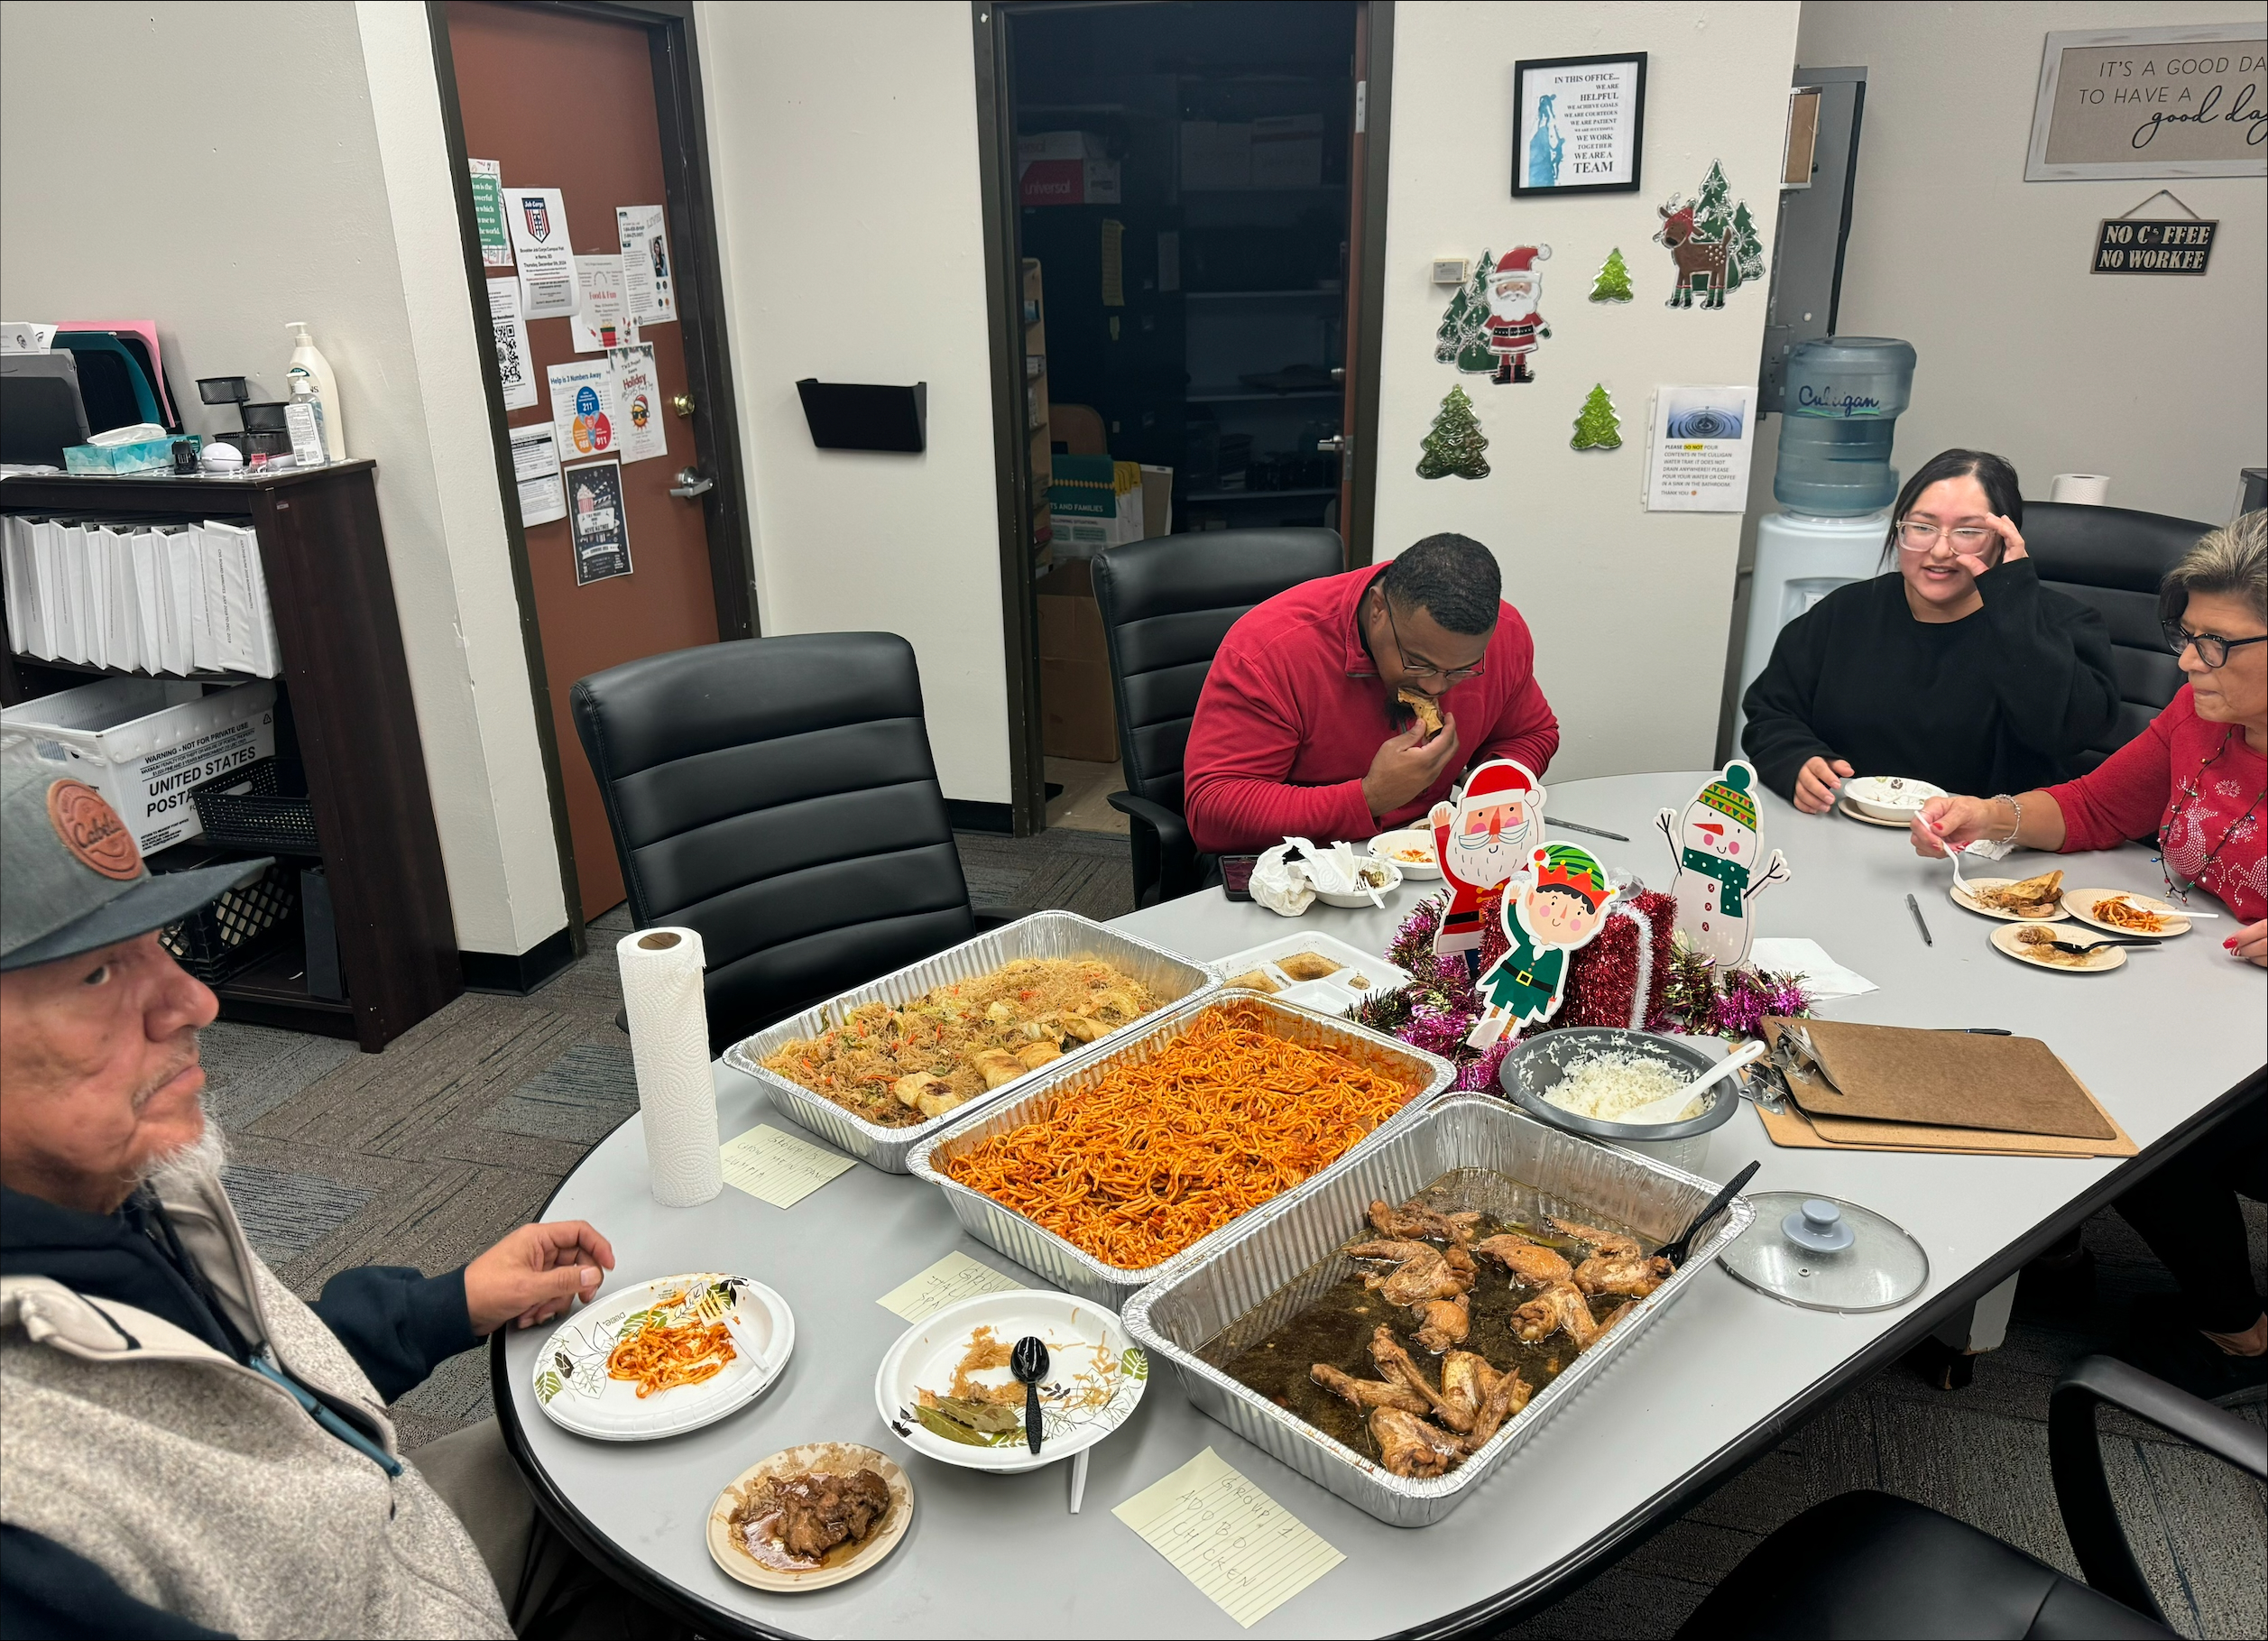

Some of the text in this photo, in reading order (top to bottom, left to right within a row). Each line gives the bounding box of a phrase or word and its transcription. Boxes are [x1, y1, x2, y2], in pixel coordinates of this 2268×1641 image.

[2099, 56, 2267, 78] IT'S A GOOD DA
[1565, 75, 1583, 83] THIS
[1580, 92, 1618, 102] HELPFUL
[2079, 86, 2191, 105] TO HAVE A
[2131, 85, 2223, 149] good
[1574, 151, 1613, 160] WE ARE A
[1572, 161, 1613, 174] TEAM
[1024, 180, 1071, 195] universal
[532, 201, 544, 209] Corps
[2104, 226, 2134, 244] NO
[2098, 249, 2205, 269] NO WORKEE
[589, 291, 602, 300] Food
[606, 290, 616, 299] Fun
[550, 377, 561, 385] Help
[570, 373, 588, 383] Numbers
[622, 373, 646, 390] Holiday
[583, 402, 593, 411] 211
[596, 437, 607, 446] 911
[1074, 503, 1103, 512] FAMILIES
[144, 748, 178, 764] WARNING
[182, 742, 196, 751] NOT
[197, 736, 210, 746] FOR
[210, 726, 235, 742] PRIVATE
[236, 722, 249, 732] USE
[161, 760, 178, 770] PENALTY
[186, 751, 198, 761] THEFT
[149, 746, 256, 797] UNITED STATES
[146, 788, 194, 818] POSTA
[737, 1141, 765, 1157] CHOW
[920, 1291, 941, 1311] SPA
[1220, 1477, 1271, 1519] GROUP
[1175, 1489, 1248, 1550] ADOBO
[1173, 1521, 1258, 1588] CHICKEN
